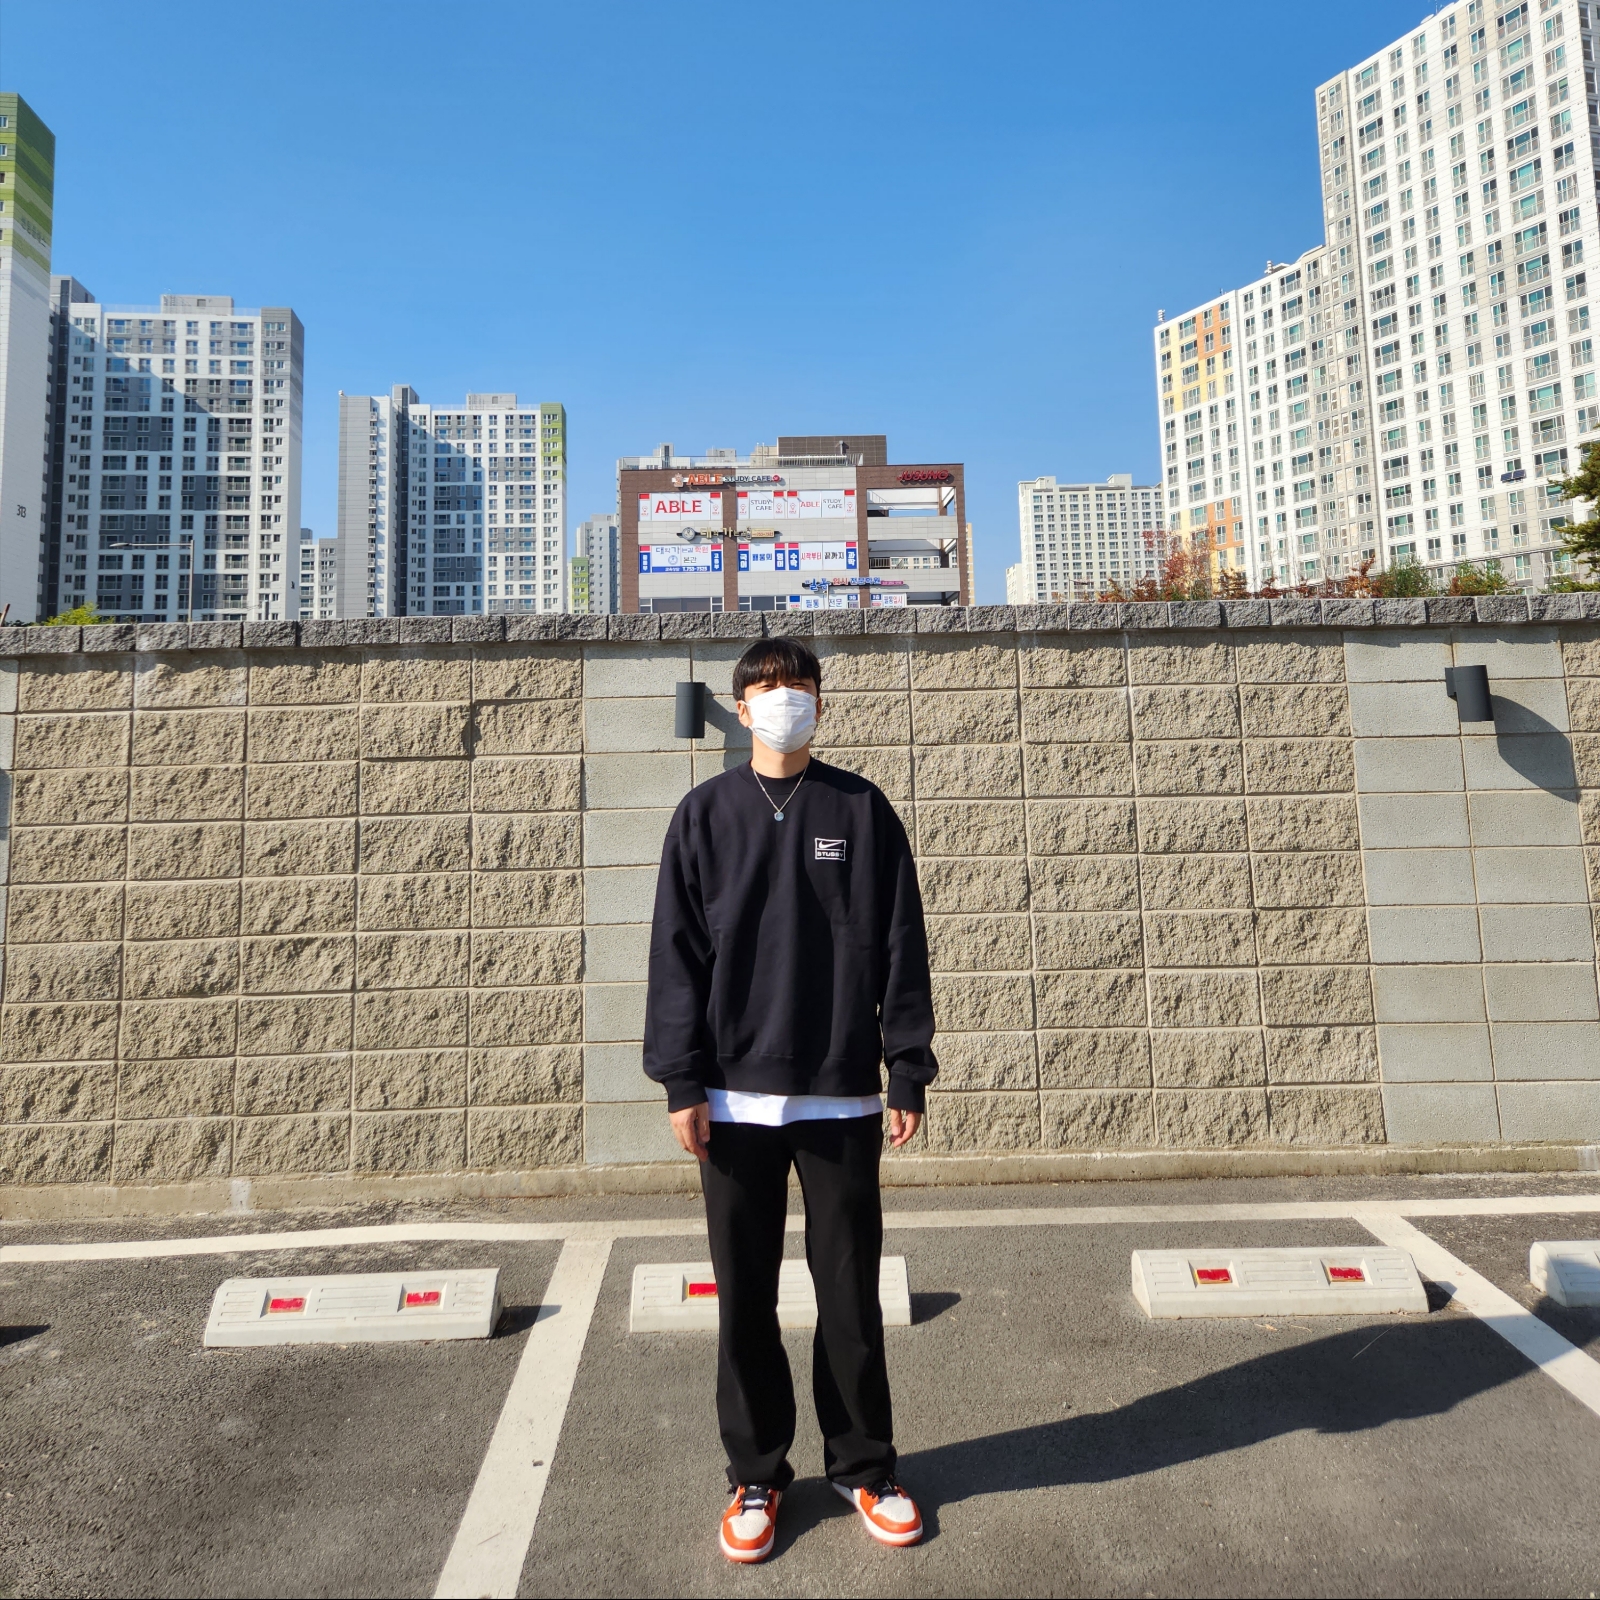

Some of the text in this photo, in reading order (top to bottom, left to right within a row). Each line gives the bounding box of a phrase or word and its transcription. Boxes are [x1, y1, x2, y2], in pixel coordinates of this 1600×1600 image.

[687, 473, 723, 485] ABLE
[655, 500, 702, 513] ABLE
[789, 553, 798, 567] 수학
[801, 552, 822, 560] 시작부터
[824, 552, 845, 560] 끝까지
[832, 577, 848, 586] 입시
[849, 577, 881, 585] 전문학원
